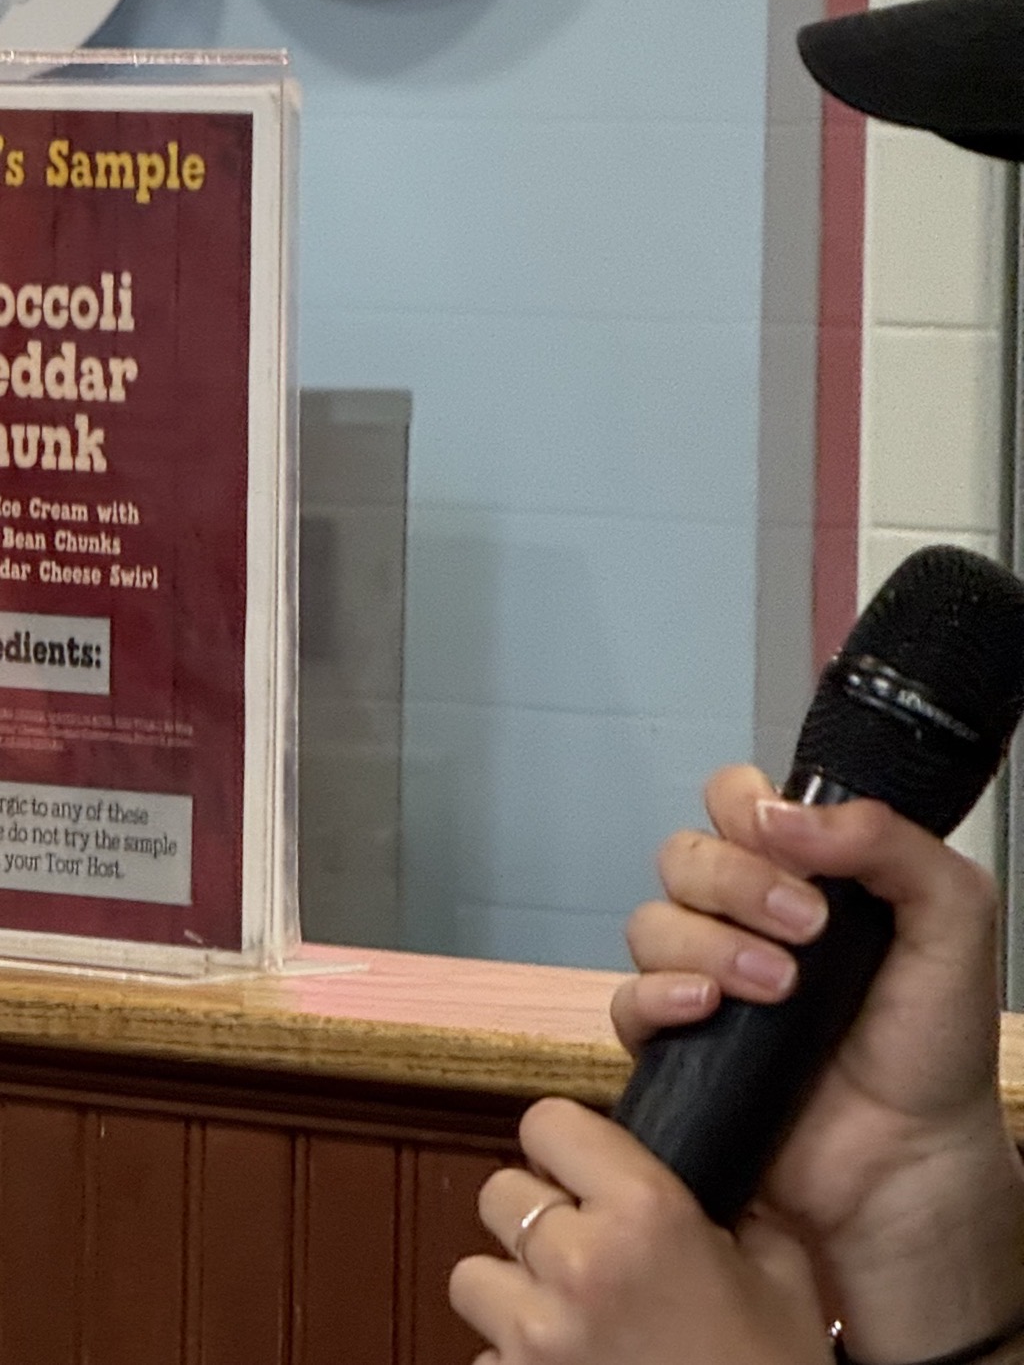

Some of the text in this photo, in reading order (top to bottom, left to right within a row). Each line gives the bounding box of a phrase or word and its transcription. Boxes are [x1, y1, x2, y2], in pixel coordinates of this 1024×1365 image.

[46, 139, 206, 203] Sample
[29, 497, 89, 522] Cream
[97, 501, 140, 525] with
[2, 527, 46, 551] Bean
[54, 530, 121, 555] Chunks
[39, 561, 101, 585] Cheese
[110, 564, 159, 589] Swirl
[32, 798, 48, 817] to
[51, 802, 82, 822] any
[86, 800, 104, 821] of
[108, 803, 149, 825] these
[8, 822, 27, 842] do
[33, 826, 59, 844] not
[64, 828, 89, 852] try
[95, 829, 120, 851] the
[124, 832, 177, 859] sample
[5, 852, 41, 873] your
[46, 853, 83, 876] Tour
[88, 856, 125, 879] Host.
